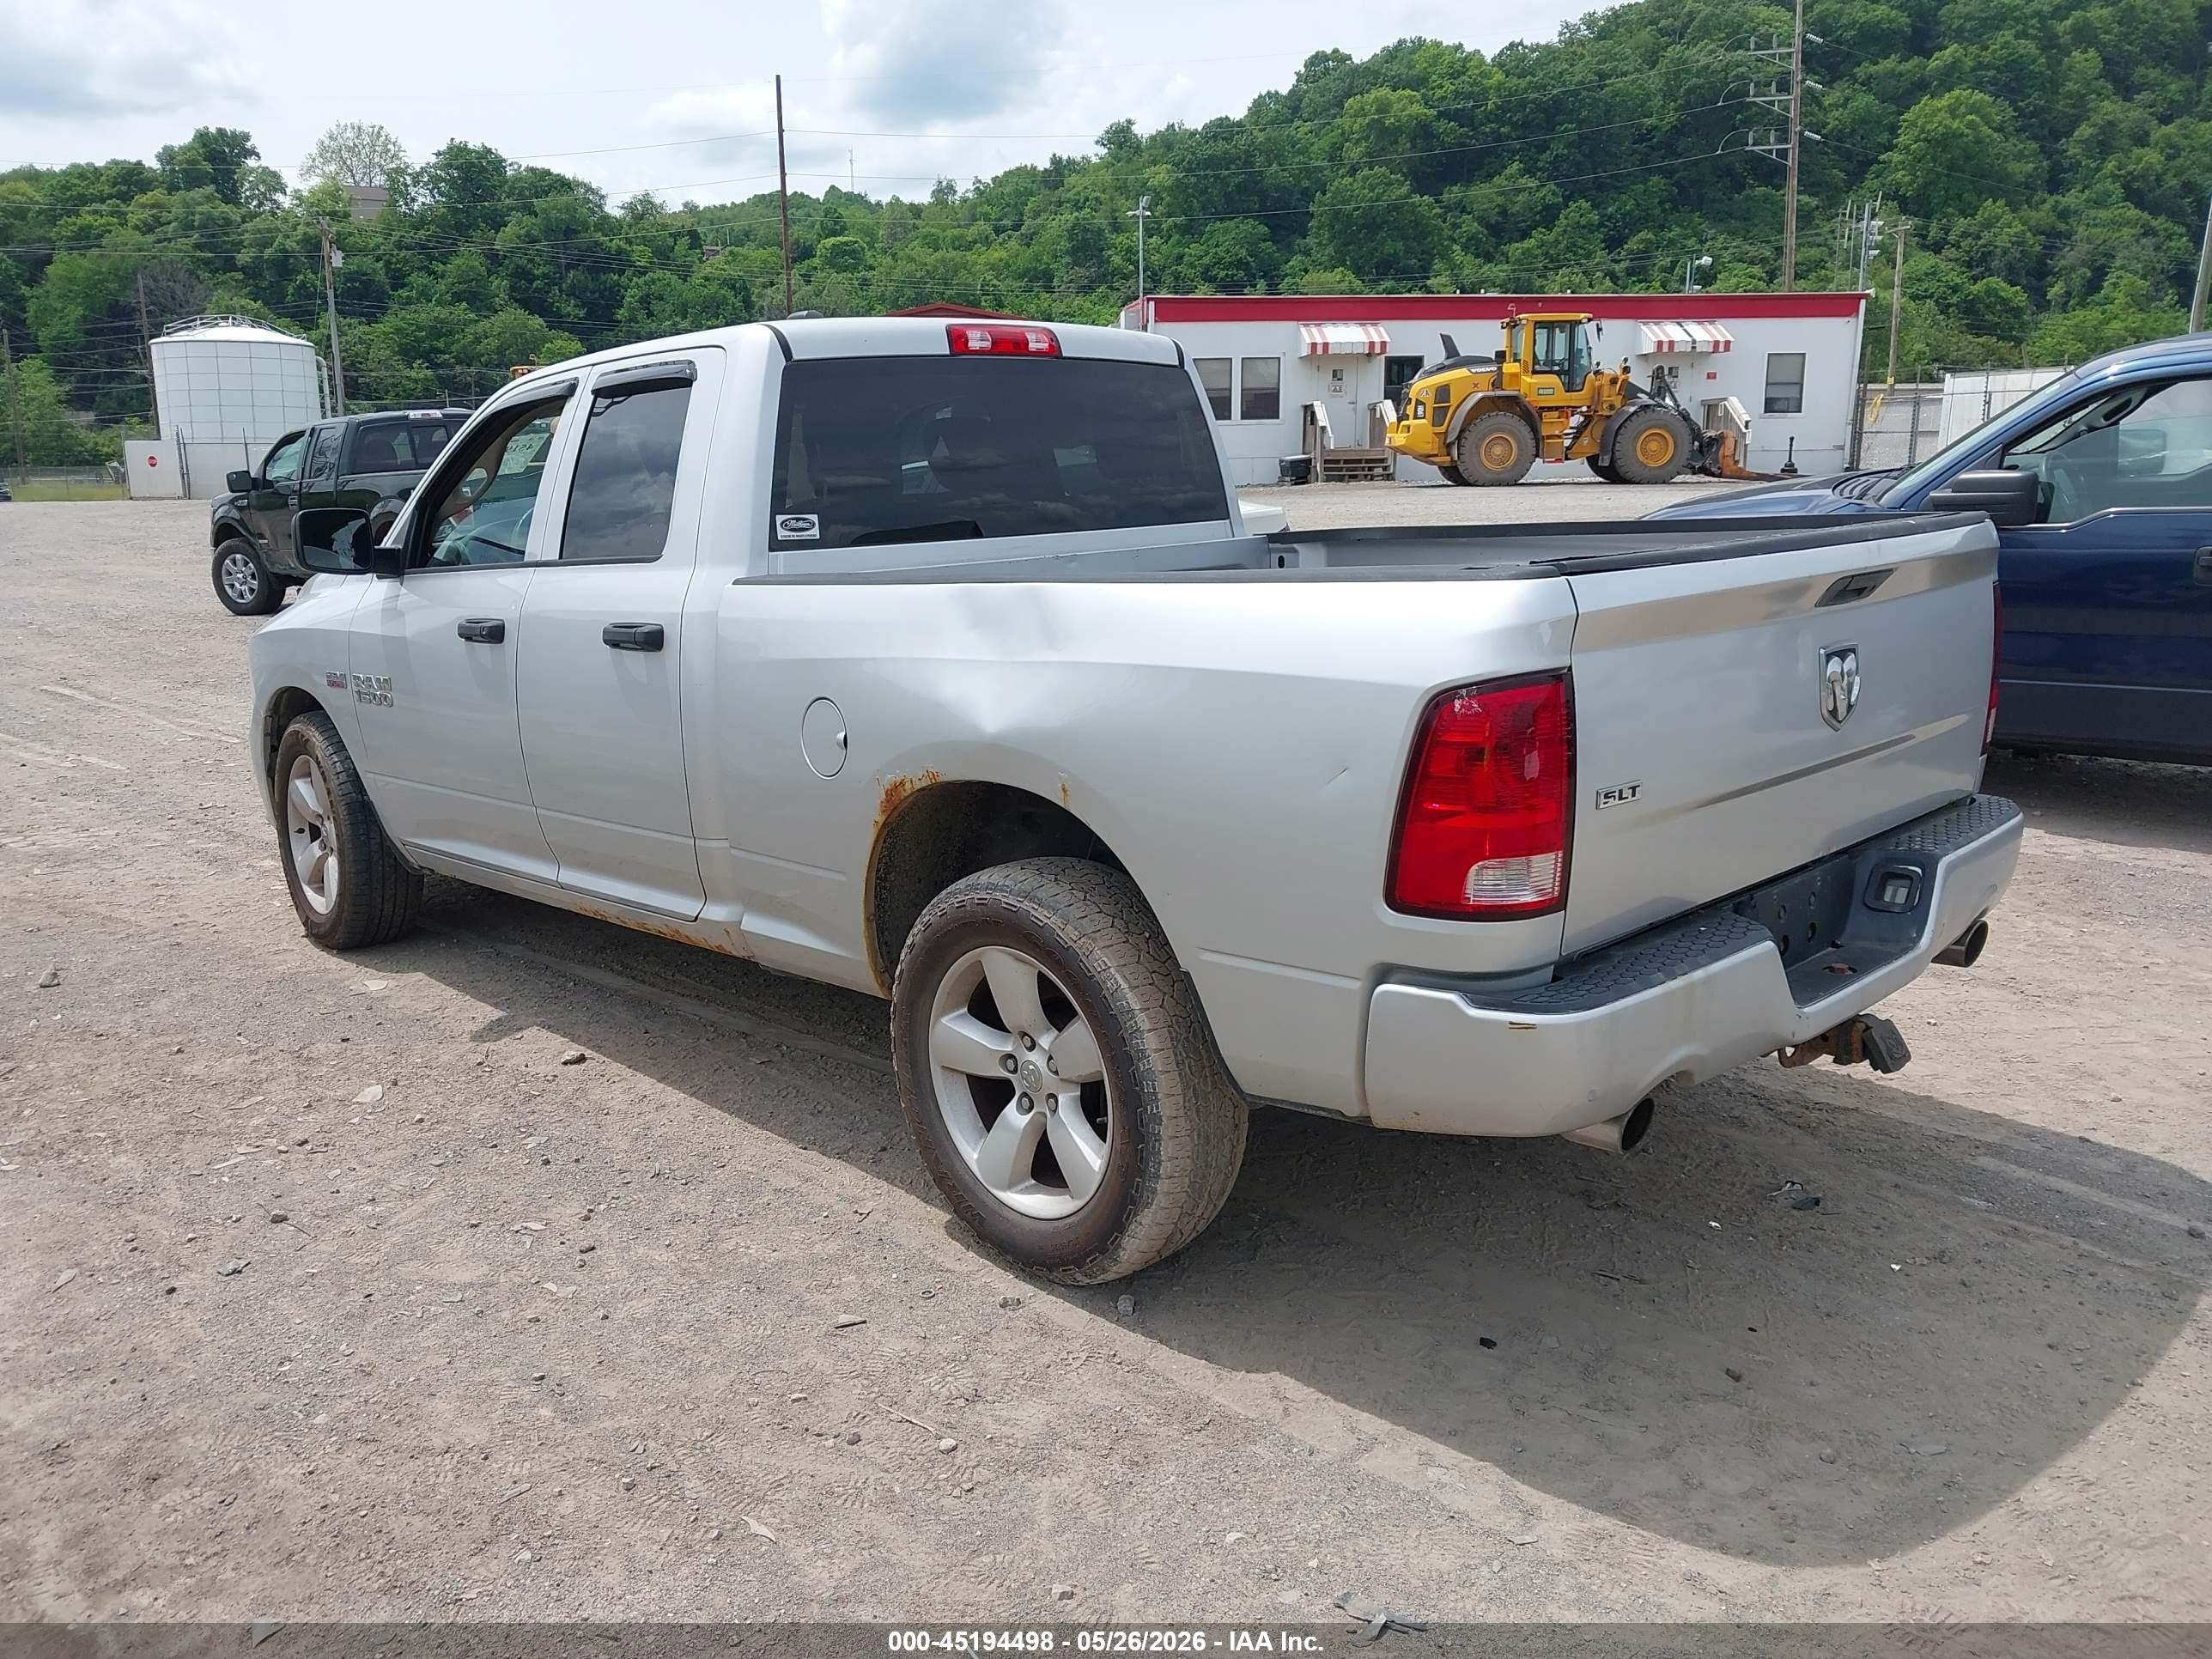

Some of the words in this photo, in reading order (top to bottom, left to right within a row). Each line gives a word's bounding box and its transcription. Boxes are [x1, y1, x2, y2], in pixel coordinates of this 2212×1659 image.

[352, 673, 392, 691] RAM
[354, 690, 393, 708] 1500
[1602, 784, 1641, 805] SLT
